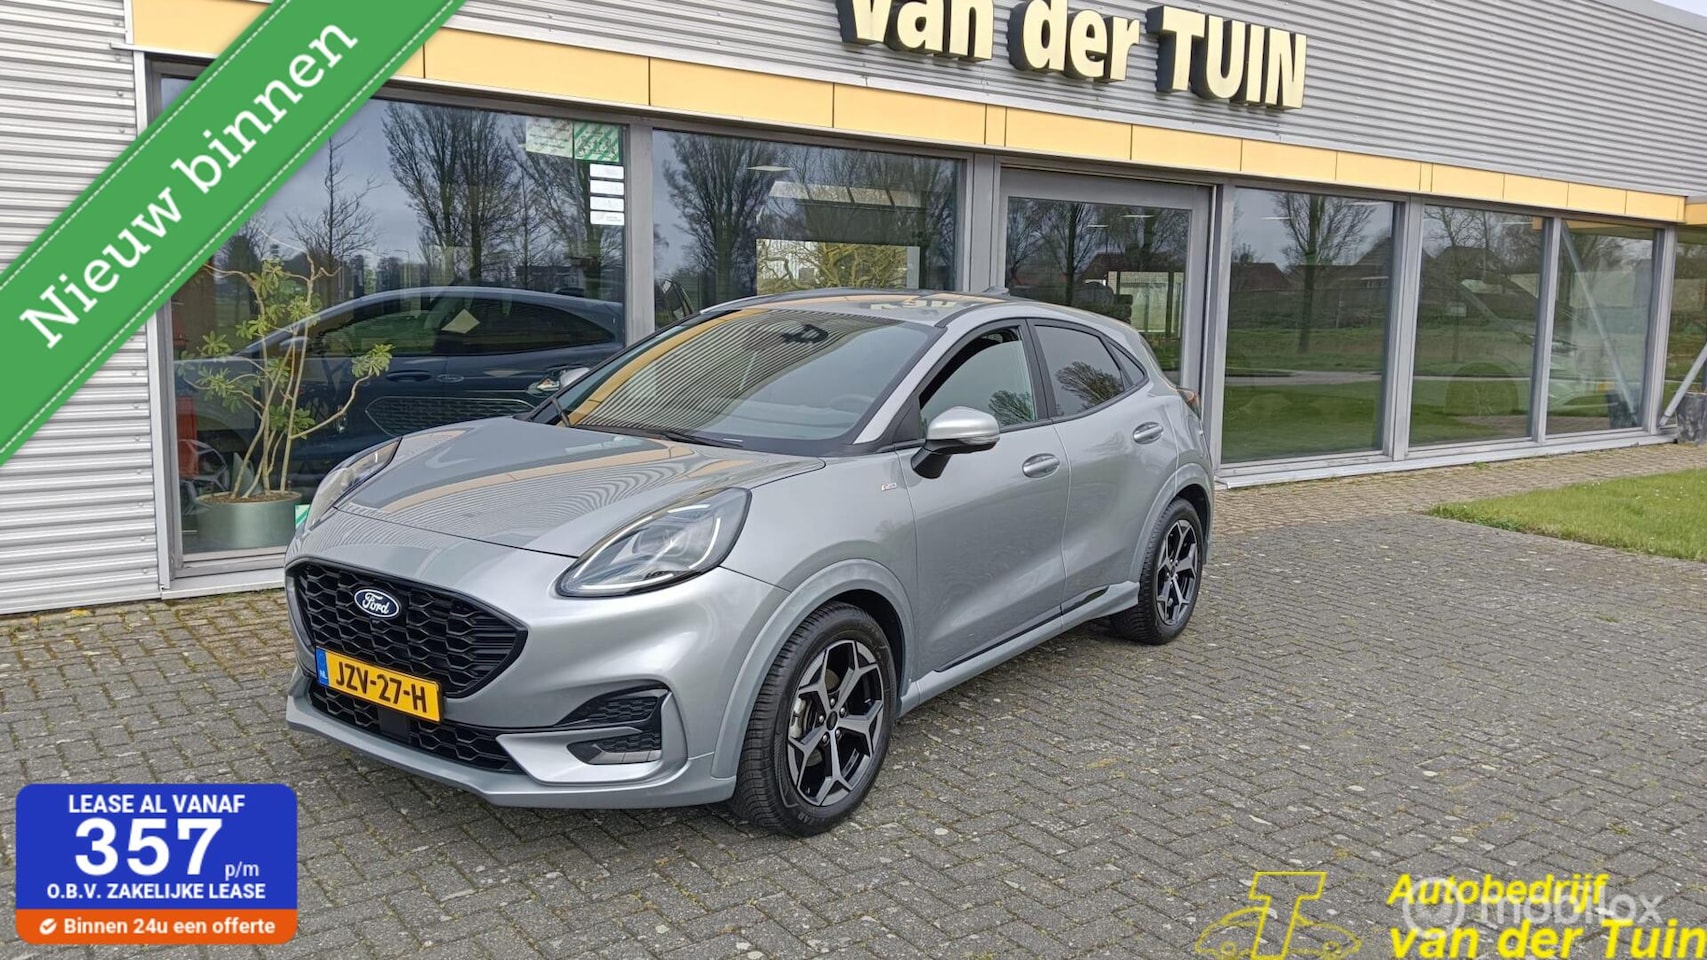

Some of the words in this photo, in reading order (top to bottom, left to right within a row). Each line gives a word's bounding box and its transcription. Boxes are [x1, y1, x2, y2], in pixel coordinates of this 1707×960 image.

[845, 0, 994, 61] van
[1012, 0, 1140, 81] der
[1158, 5, 1307, 109] TUIN
[362, 592, 390, 614] Ford
[335, 661, 428, 713] JZV-27-H
